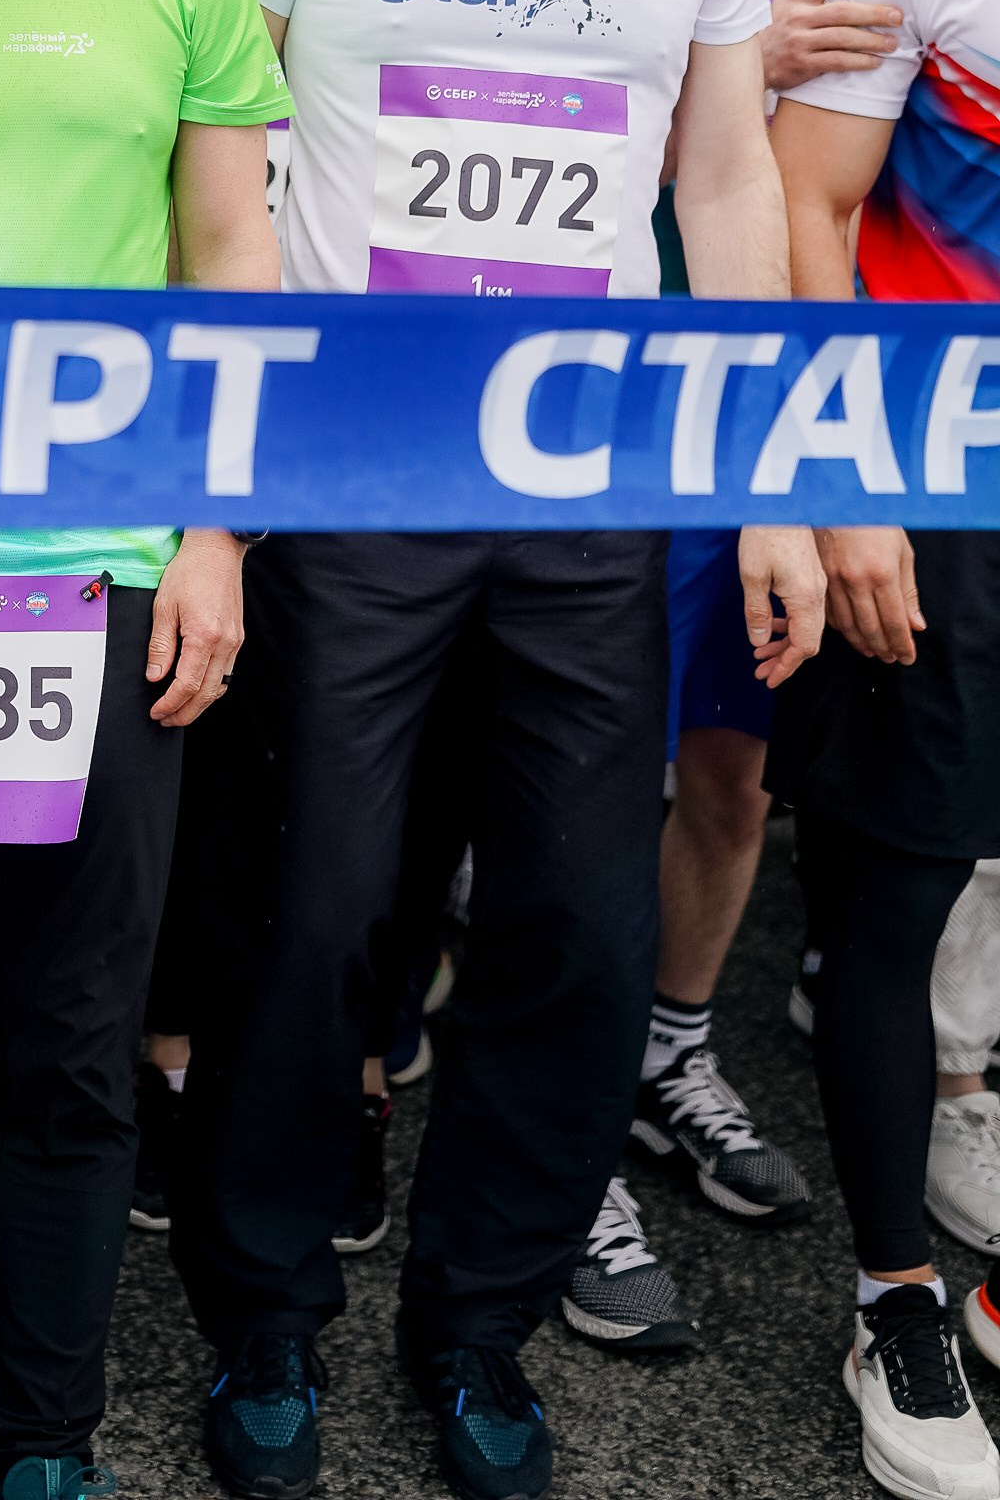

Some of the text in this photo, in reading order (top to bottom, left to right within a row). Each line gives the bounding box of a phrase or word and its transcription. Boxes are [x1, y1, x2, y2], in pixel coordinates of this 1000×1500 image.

[9, 31, 66, 42] зелёный
[2, 43, 62, 53] марафон
[443, 88, 477, 99] СБЕР
[497, 91, 530, 99] зелёный
[492, 97, 527, 106] марафон
[408, 149, 600, 232] 2072
